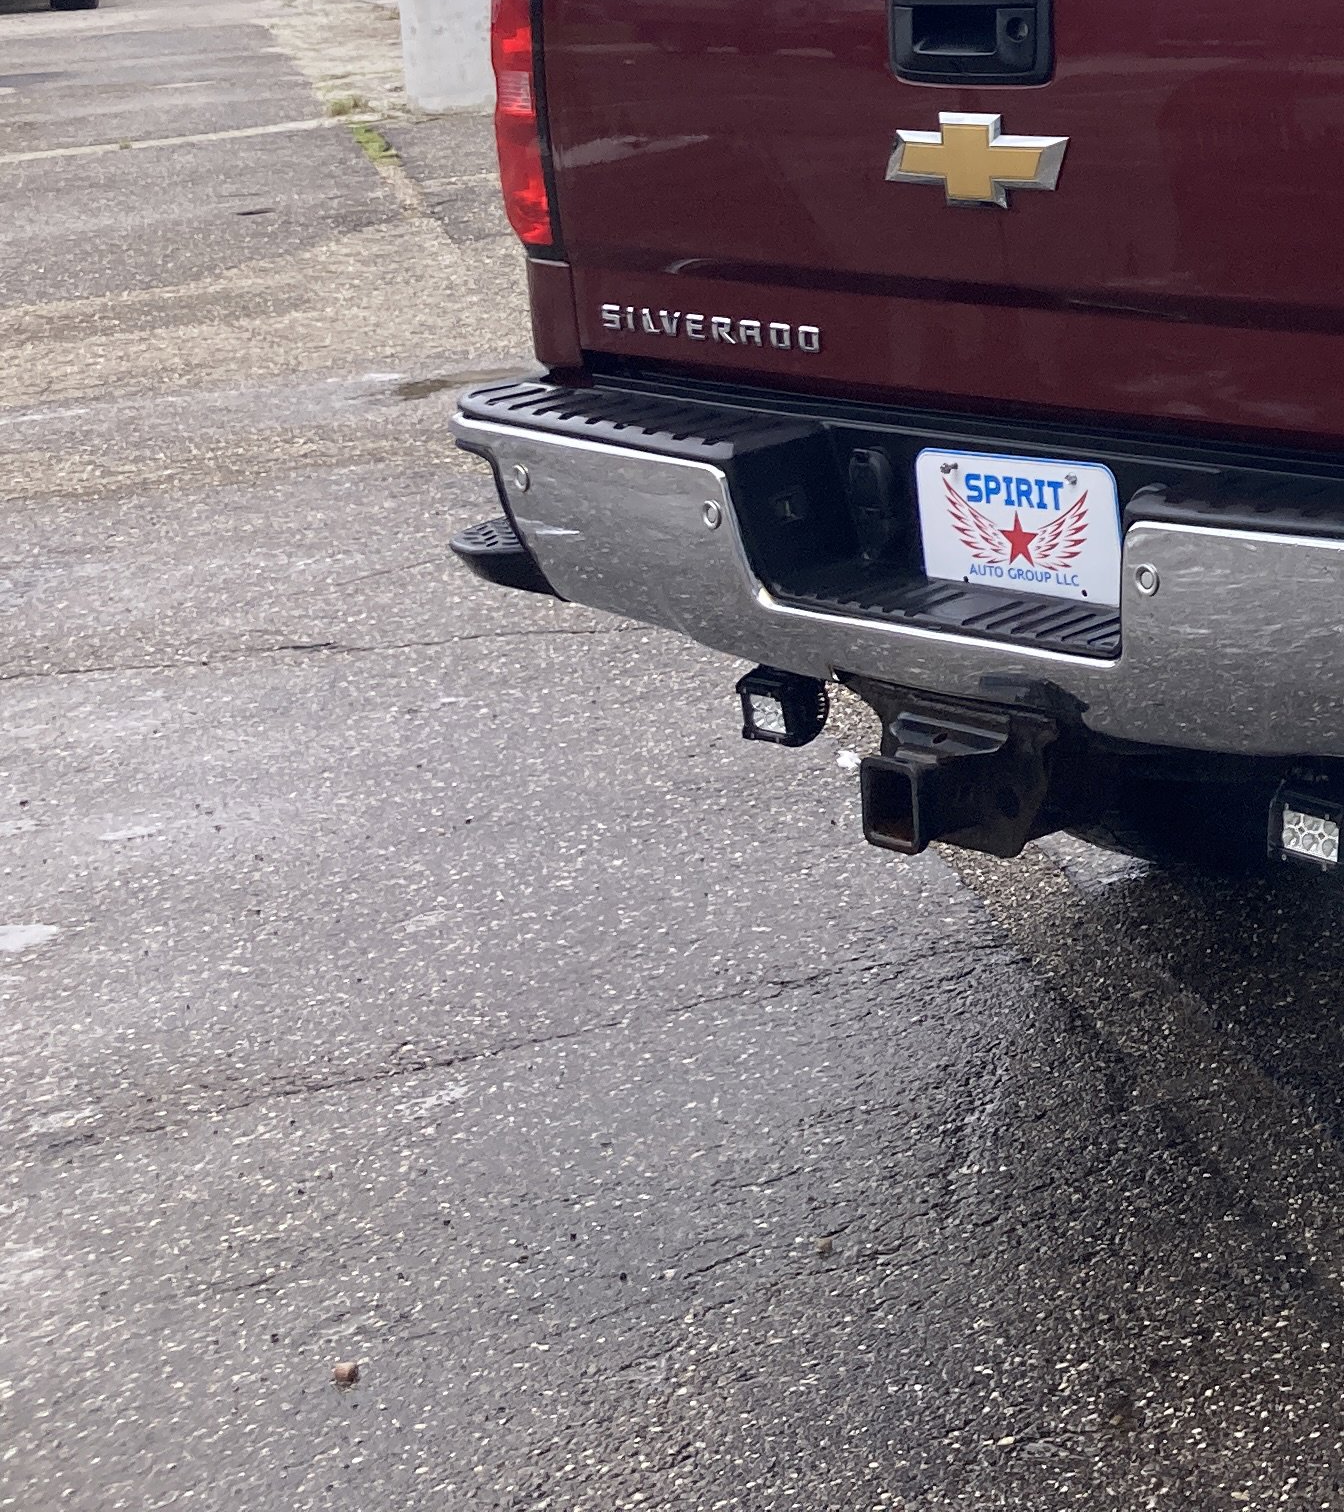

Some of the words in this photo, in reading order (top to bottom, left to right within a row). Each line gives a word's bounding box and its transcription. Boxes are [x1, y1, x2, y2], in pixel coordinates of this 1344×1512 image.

[601, 303, 820, 353] SILVERADO
[964, 473, 1064, 511] SPIRIT
[969, 563, 1004, 578] AUTO
[1007, 567, 1051, 584] GROUP
[1055, 572, 1080, 587] LLC
